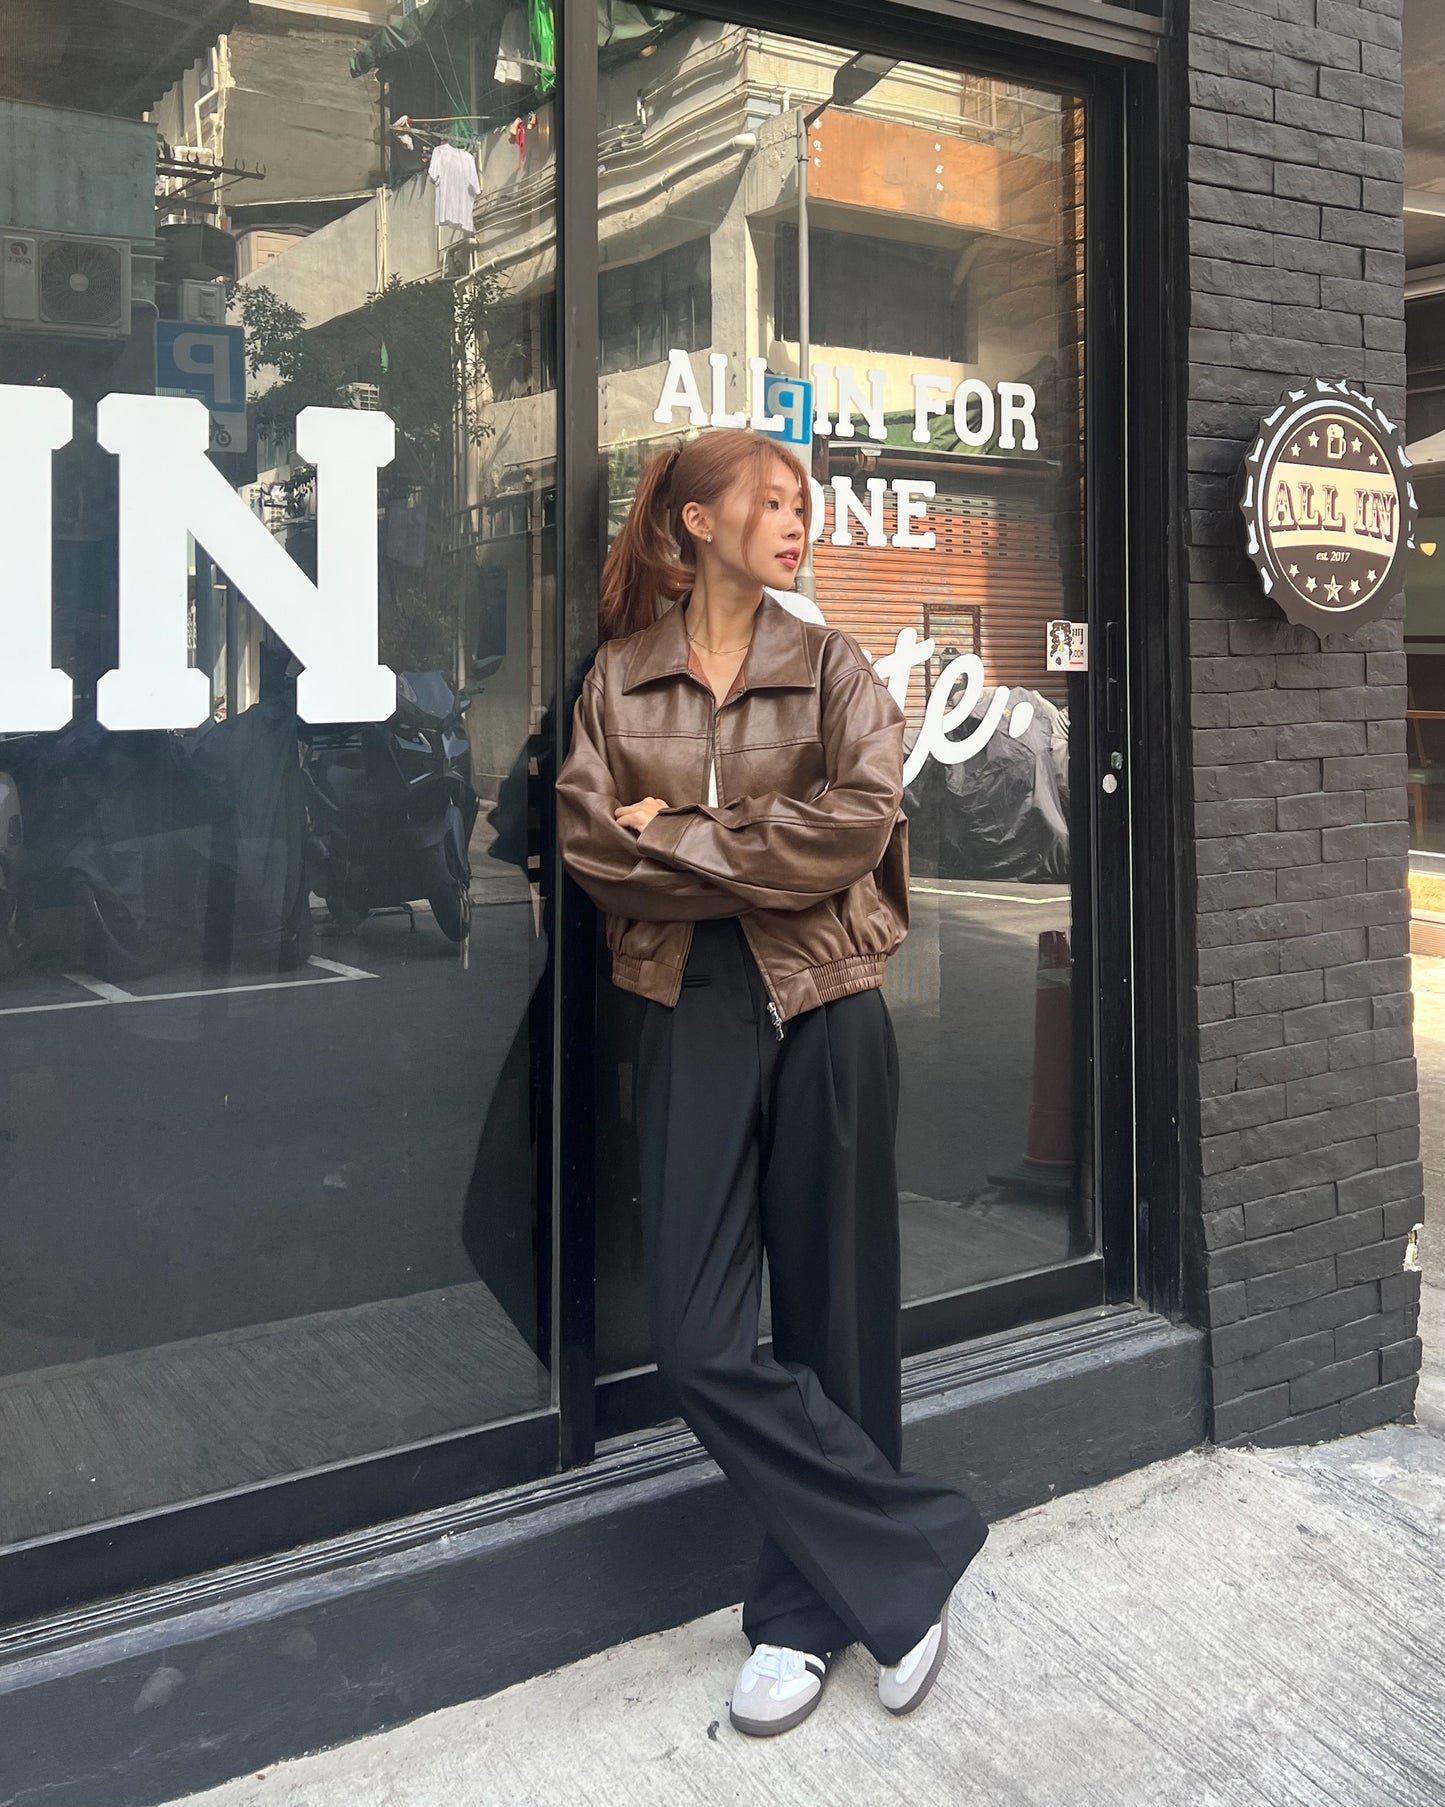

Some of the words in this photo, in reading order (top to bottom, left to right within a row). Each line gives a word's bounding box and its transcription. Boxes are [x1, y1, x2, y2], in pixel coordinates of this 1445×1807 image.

[653, 348, 785, 432] ALL
[812, 363, 888, 440] IN
[912, 373, 1040, 451] FOR
[1269, 480, 1346, 532] ALL
[1353, 488, 1397, 543] IN
[1315, 552, 1329, 561] est.
[1330, 551, 1351, 562] 2017
[1072, 649, 1084, 658] OOR
